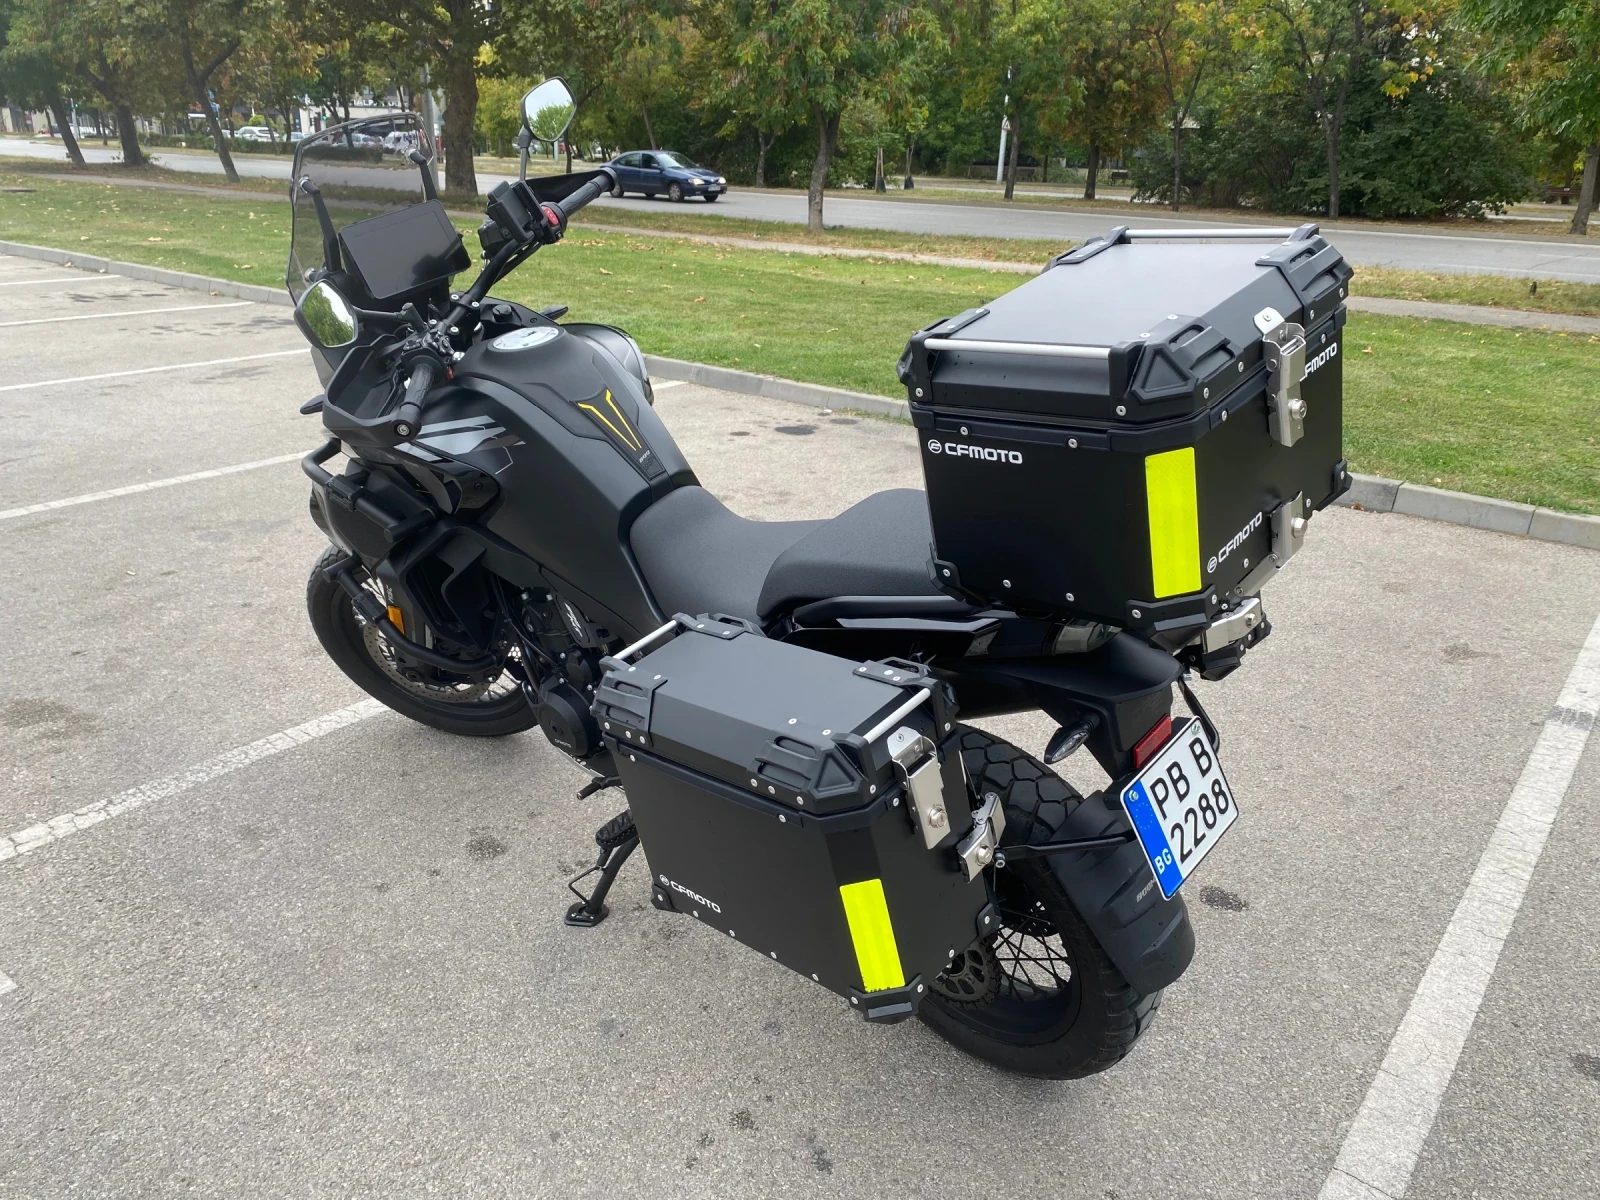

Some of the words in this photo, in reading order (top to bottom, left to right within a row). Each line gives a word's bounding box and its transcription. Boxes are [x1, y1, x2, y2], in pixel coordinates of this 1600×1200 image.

[1300, 342, 1338, 381] FMOTO
[944, 442, 1023, 464] CFMOTO
[1218, 511, 1263, 563] CFMOTO
[1149, 760, 1191, 820] PB
[1188, 737, 1213, 778] B
[1170, 778, 1230, 865] 2288
[1154, 847, 1172, 875] BG
[670, 880, 722, 914] CFMOTO
